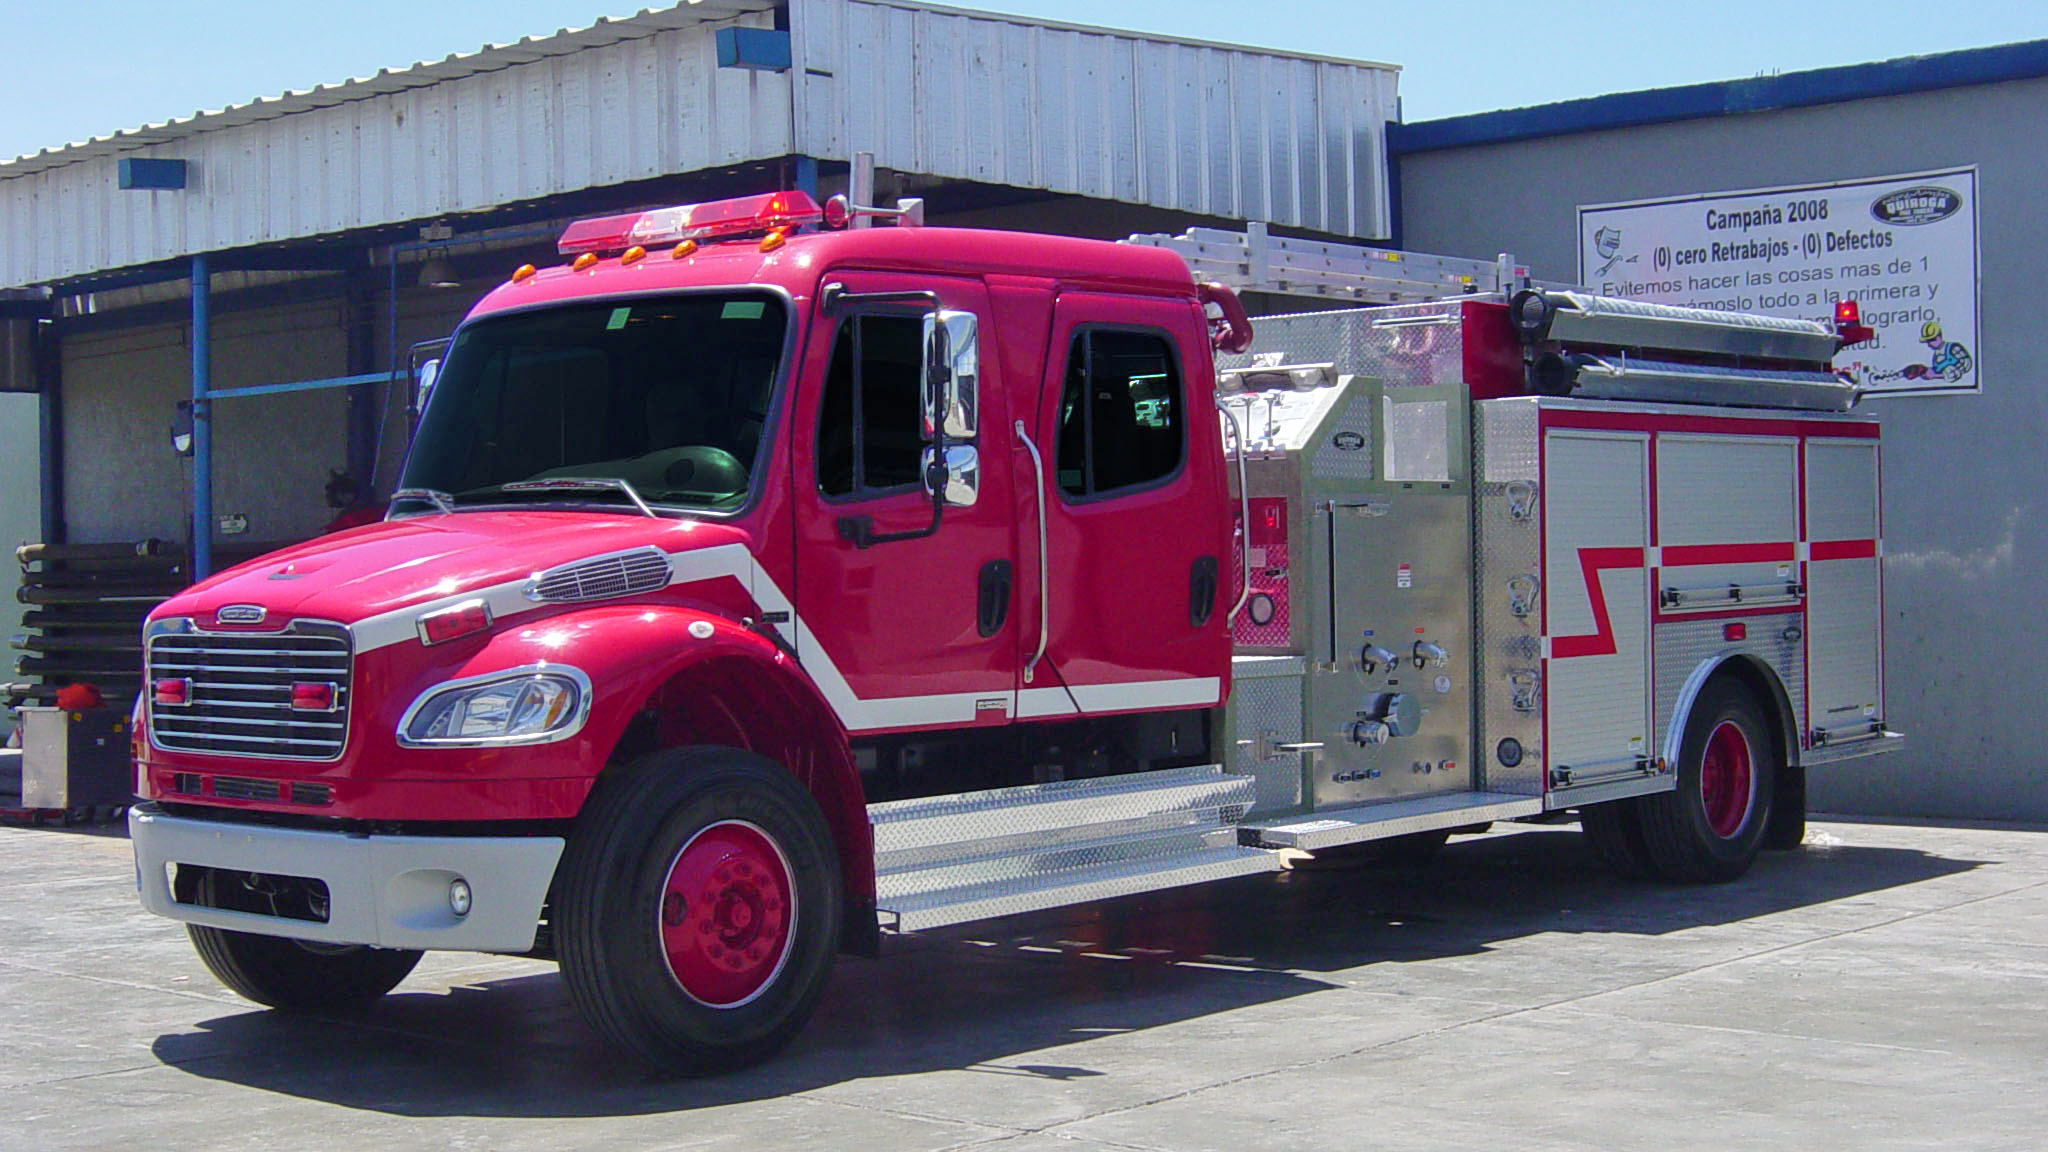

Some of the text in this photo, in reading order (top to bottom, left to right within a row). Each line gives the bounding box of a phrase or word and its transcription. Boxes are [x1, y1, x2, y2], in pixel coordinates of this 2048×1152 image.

[1706, 199, 1828, 232] Campaña 2008
[1653, 246, 1671, 272] (0)
[1676, 247, 1707, 265] cero
[1711, 237, 1789, 263] Retrabajos
[1802, 232, 1822, 259] (0)
[1826, 229, 1893, 252] Defectos
[1602, 255, 1929, 297] Evitemos hacer las cosas mas de 1
[1759, 291, 1800, 309] todo
[1806, 292, 1817, 305] a
[1824, 288, 1840, 304] la
[1928, 283, 1939, 300] y
[1862, 305, 1941, 328] lograrlo,
